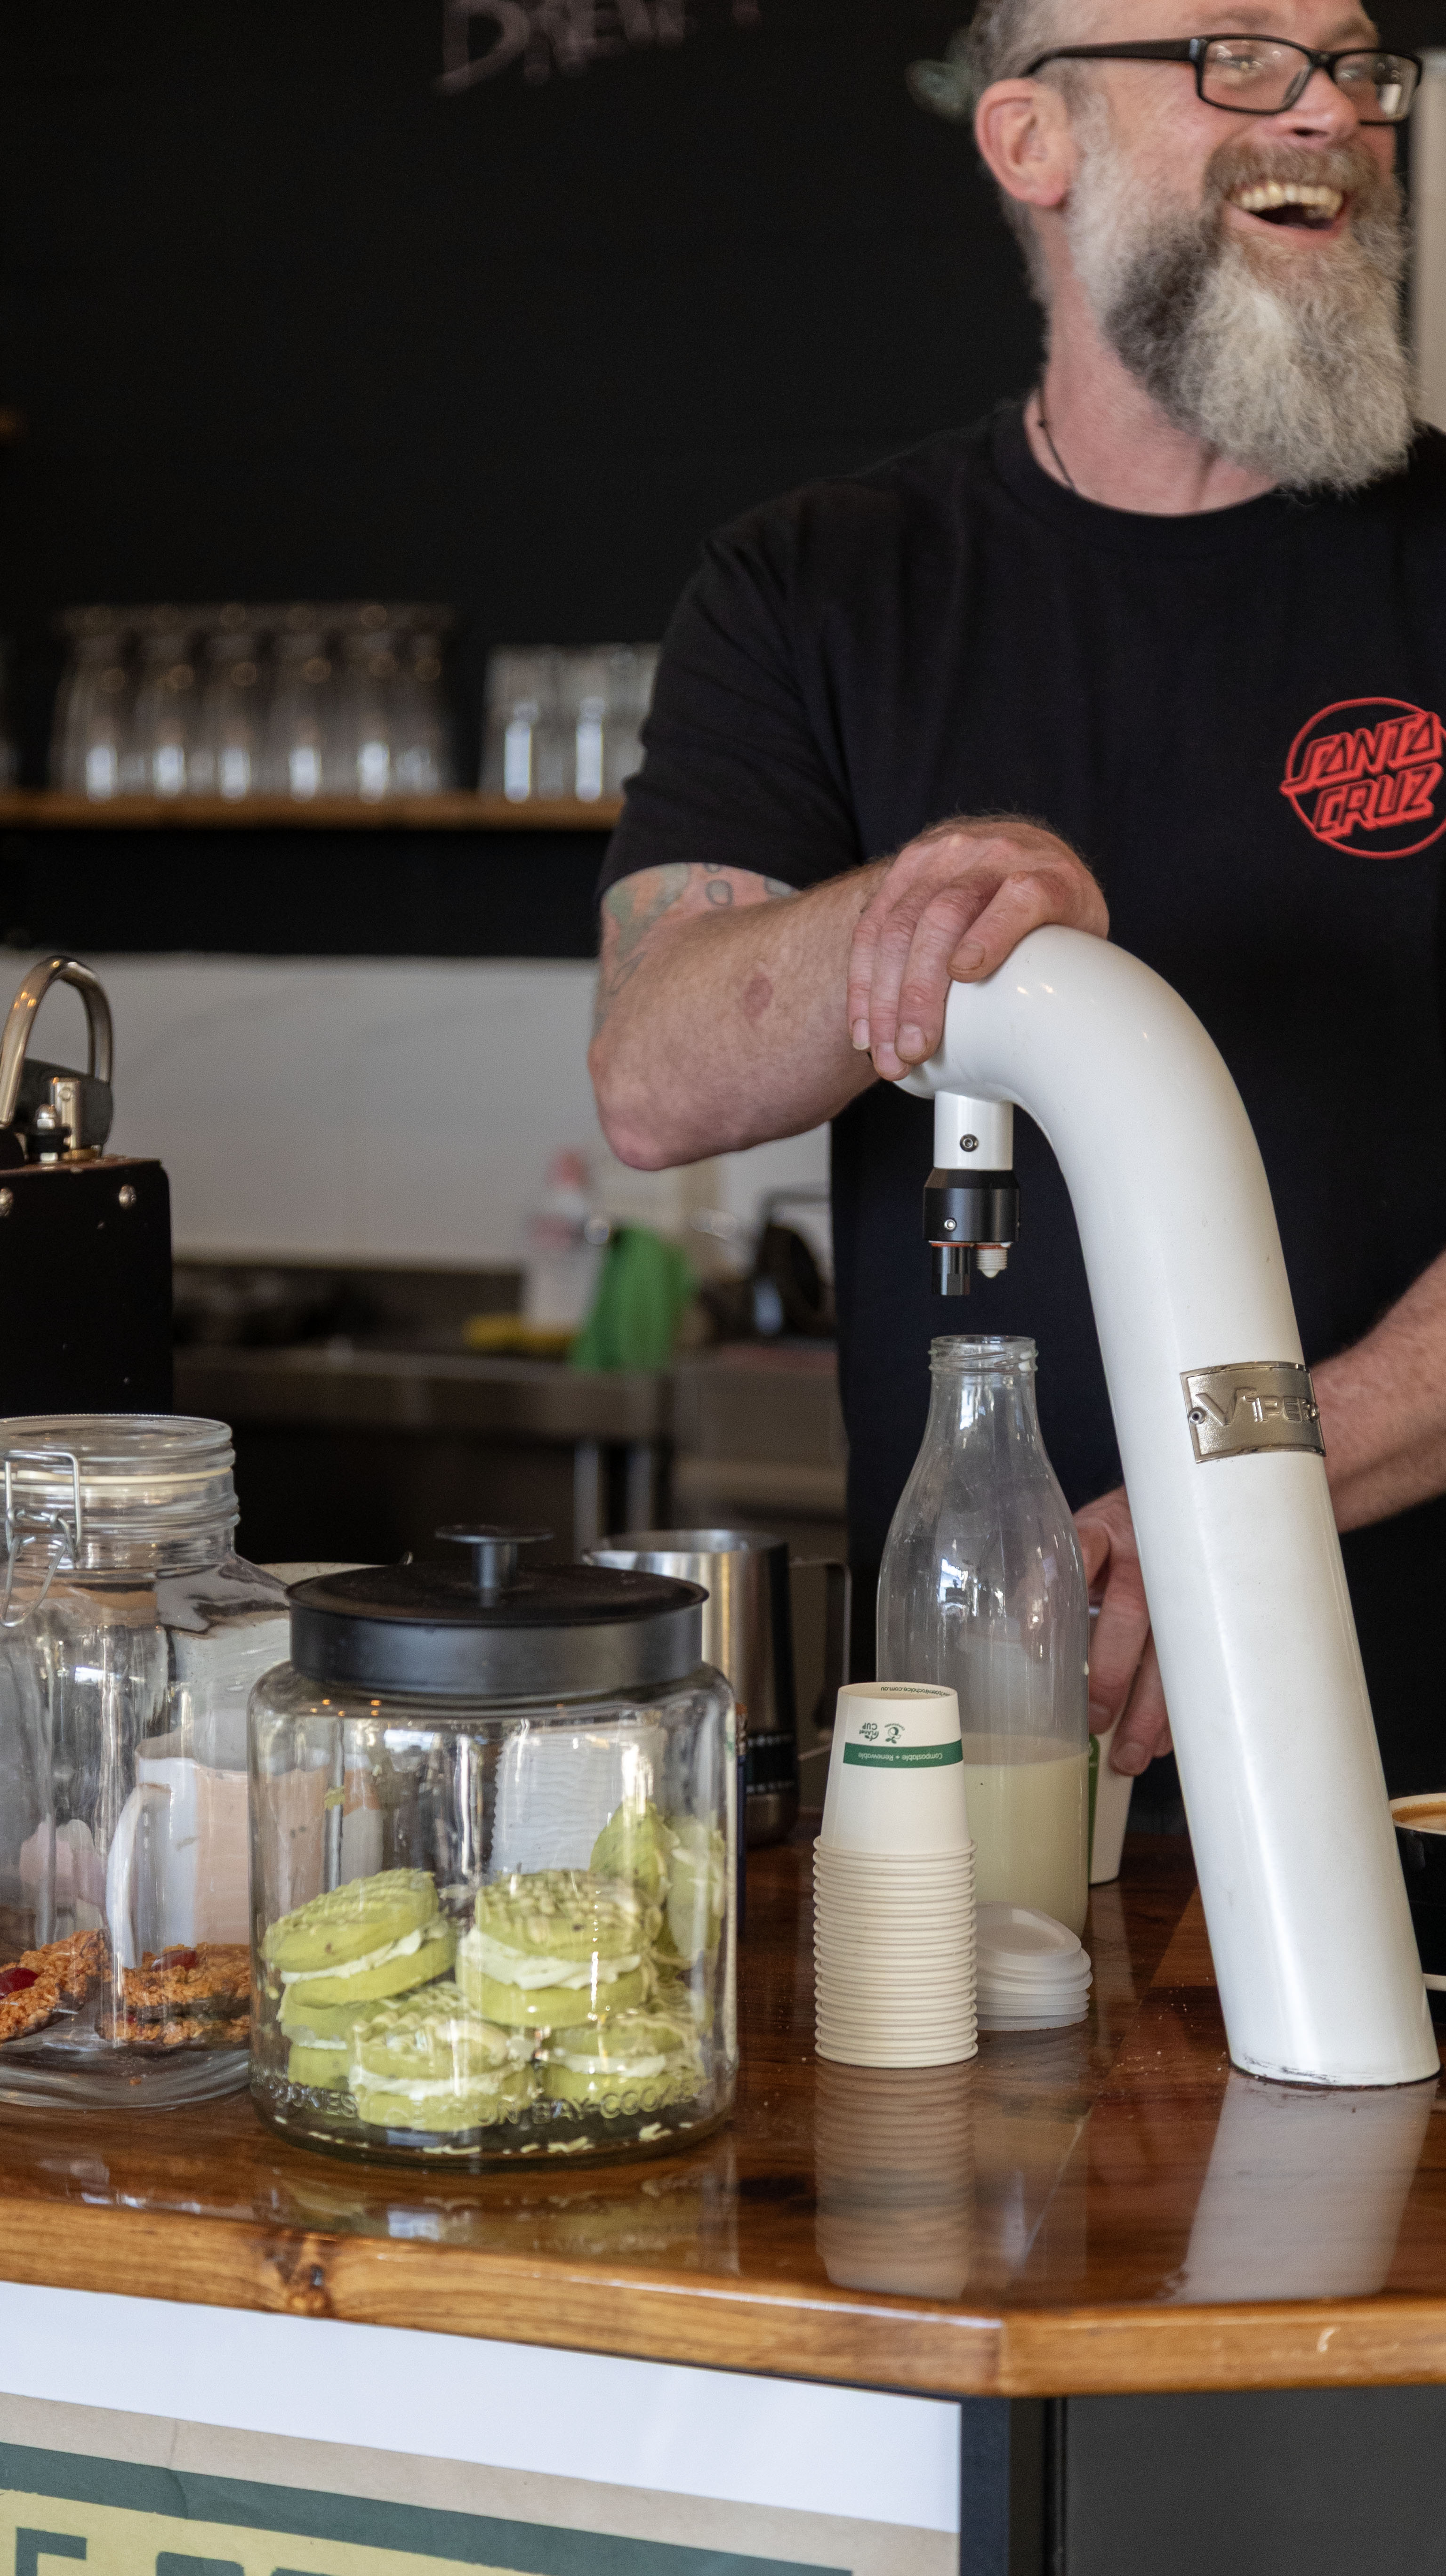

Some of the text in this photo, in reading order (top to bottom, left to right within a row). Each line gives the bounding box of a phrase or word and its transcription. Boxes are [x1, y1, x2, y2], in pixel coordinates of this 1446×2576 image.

[1279, 711, 1443, 796] SANTA
[1313, 762, 1443, 839] CRUZ
[858, 1752, 894, 1762] Renewable
[902, 1752, 943, 1762] Compostable
